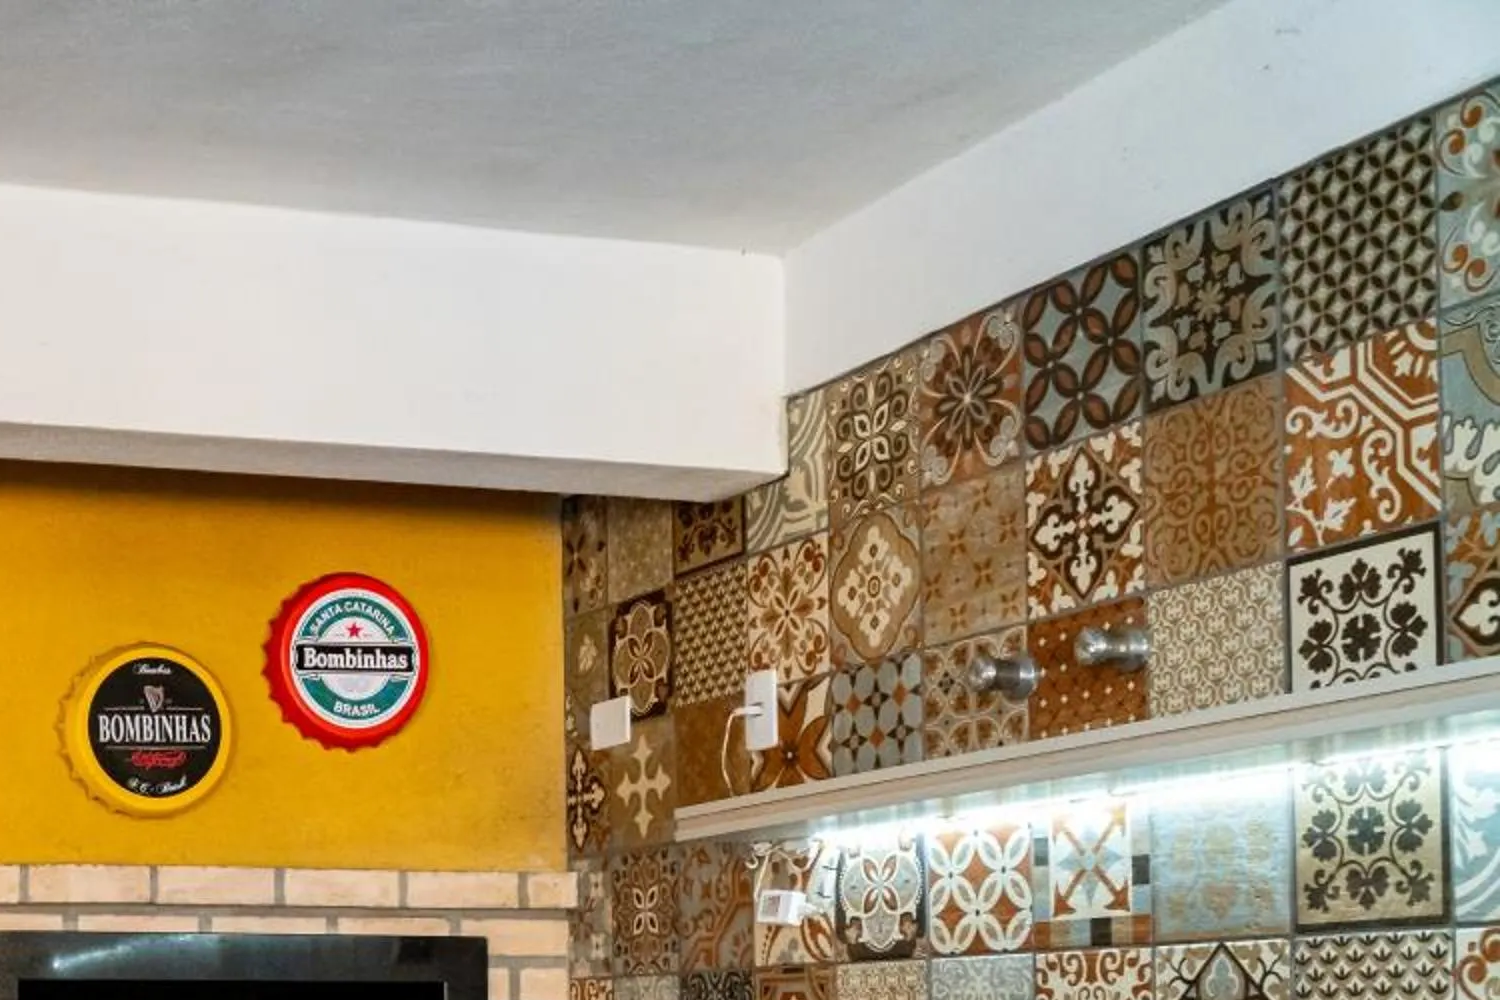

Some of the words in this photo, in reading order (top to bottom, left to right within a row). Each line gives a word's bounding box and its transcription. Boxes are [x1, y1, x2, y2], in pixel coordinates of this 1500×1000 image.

[310, 603, 342, 634] SANTA
[344, 601, 395, 634] CATARINA
[303, 647, 408, 669] Bombinhas
[333, 701, 380, 716] BRASIL
[98, 714, 212, 743] BOMBINHAS
